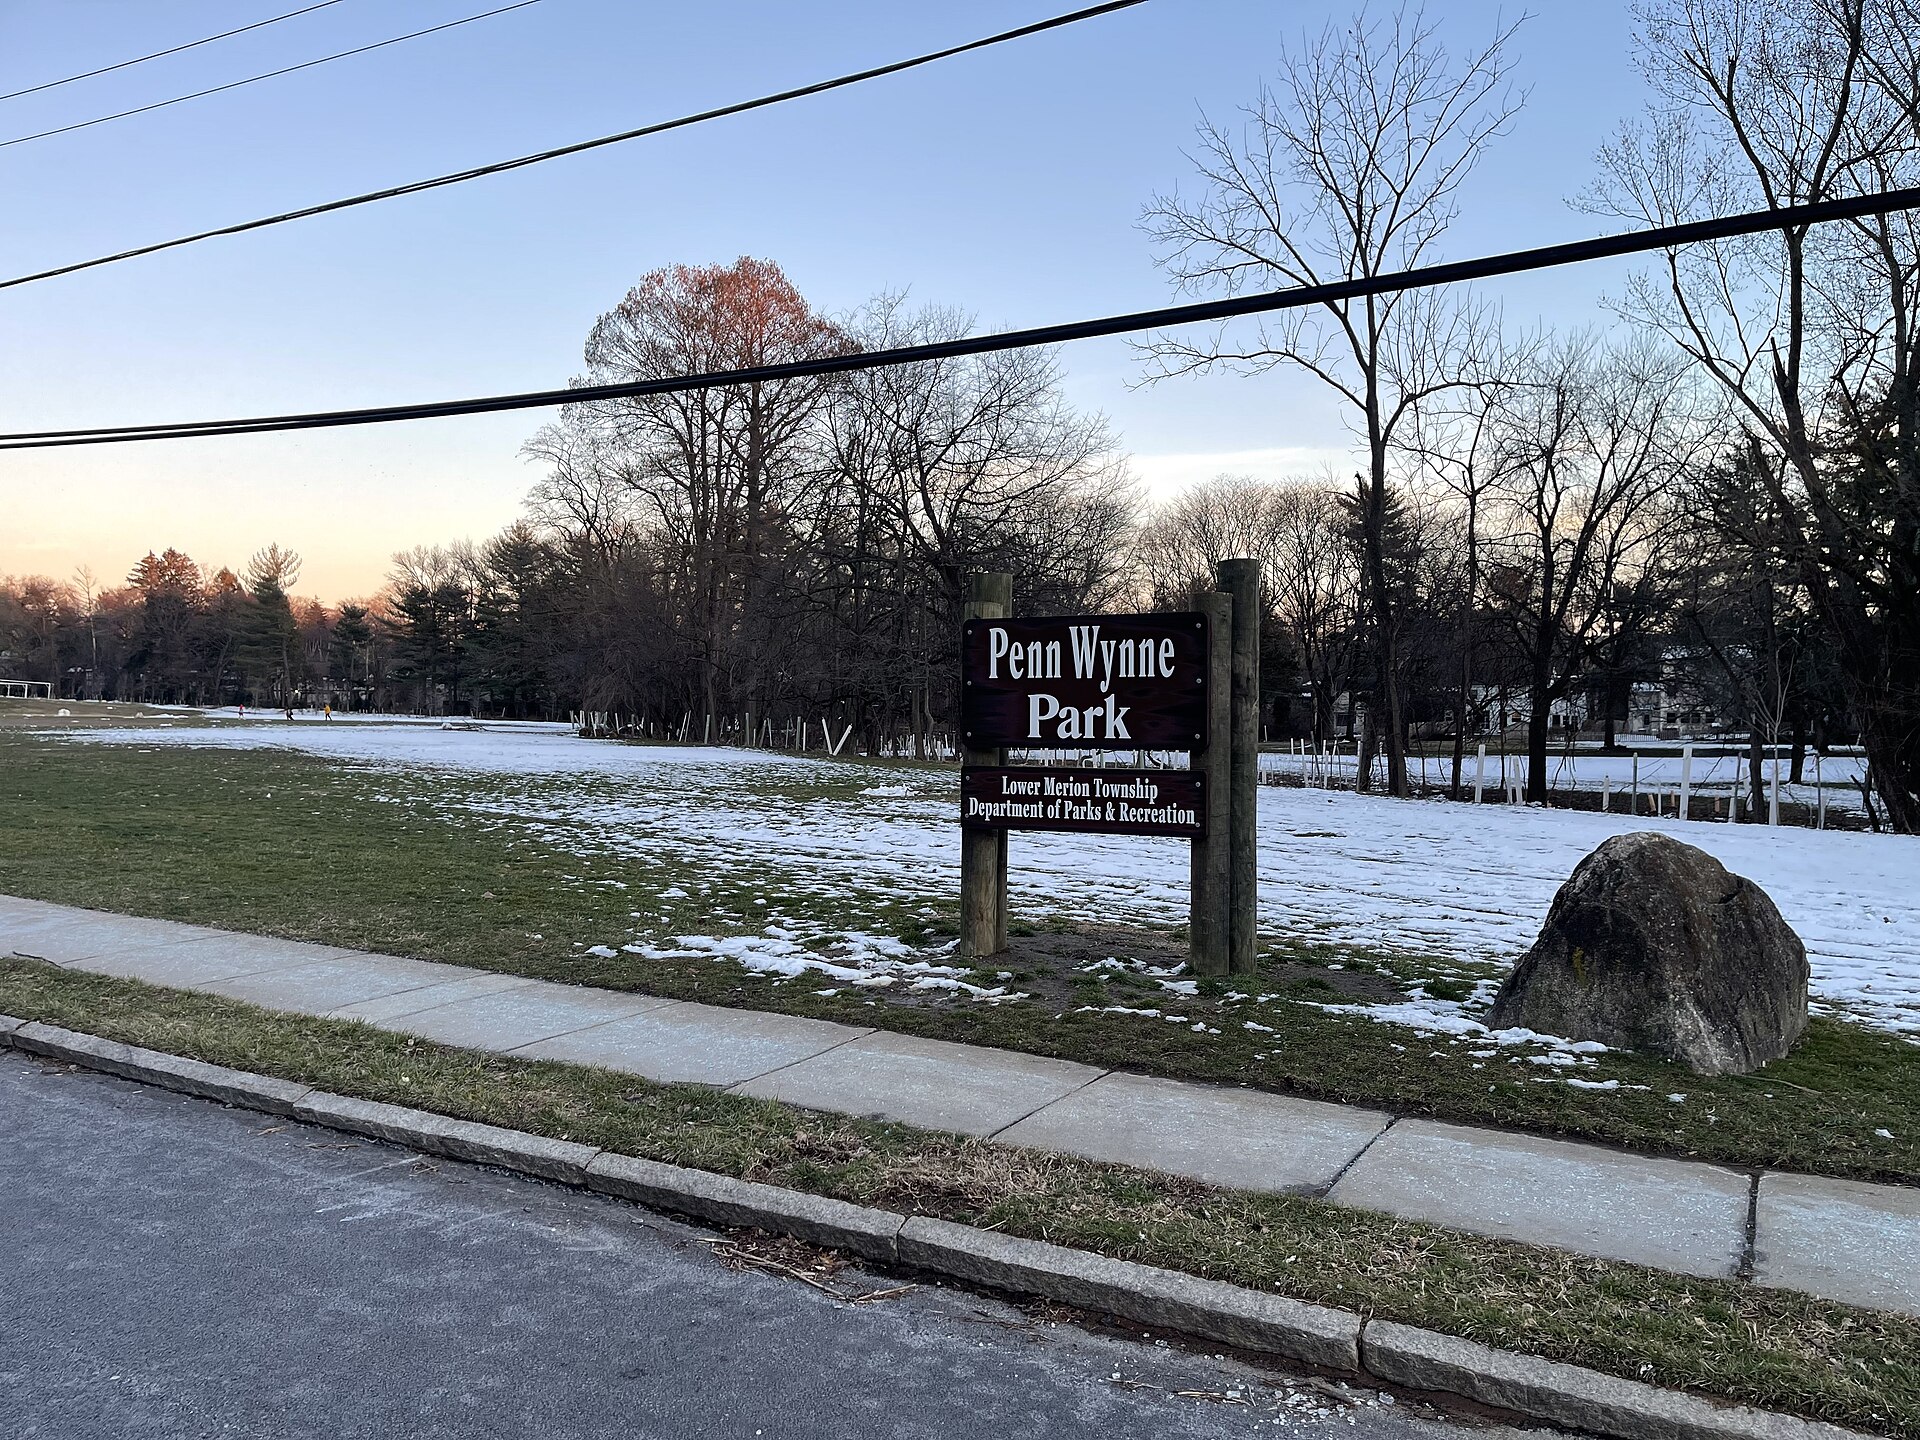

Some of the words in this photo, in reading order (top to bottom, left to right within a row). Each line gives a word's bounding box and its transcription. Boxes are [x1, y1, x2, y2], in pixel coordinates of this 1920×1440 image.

[988, 627, 1062, 680] Penn
[1068, 626, 1176, 693] Wynne
[1027, 693, 1132, 740] Park
[1001, 775, 1041, 796] Lower
[1043, 776, 1091, 797] Merion
[1093, 778, 1158, 805] Township
[968, 797, 1044, 822] Department
[1047, 798, 1062, 819] of
[1063, 800, 1102, 821] Parks
[1105, 801, 1116, 822] &
[1118, 801, 1196, 825] Recreation
